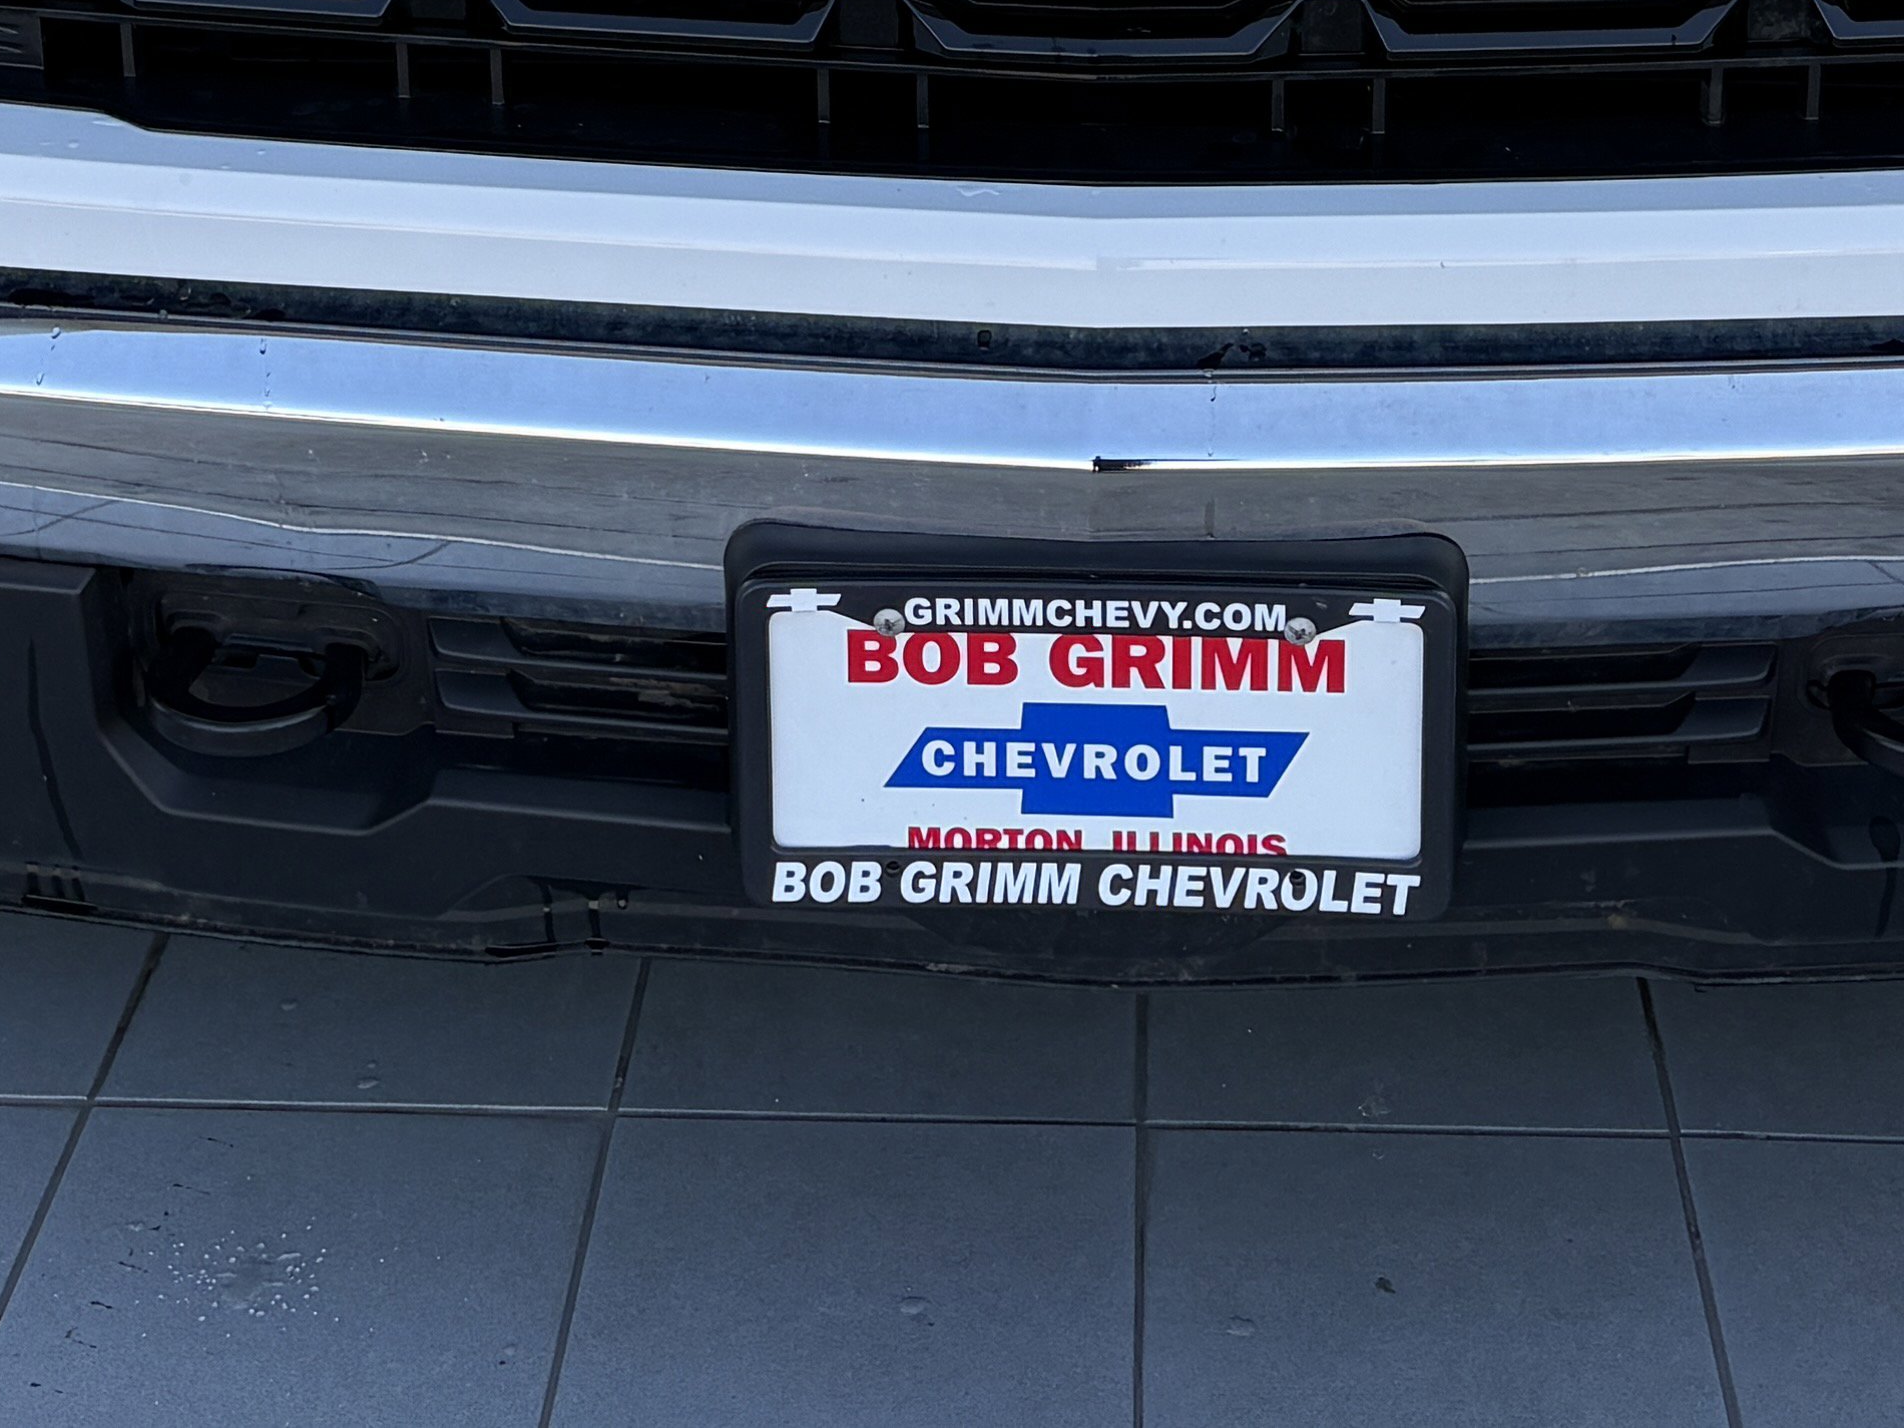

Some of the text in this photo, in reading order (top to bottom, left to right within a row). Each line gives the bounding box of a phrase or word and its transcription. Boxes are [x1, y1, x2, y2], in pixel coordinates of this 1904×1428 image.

[904, 597, 1287, 632] GRIMMCHEVY.COM
[847, 629, 1346, 693] BOB GRIMM
[921, 739, 1267, 783] CHEVROLET
[771, 860, 1422, 916] BOB GRIMM CHEVROLET
